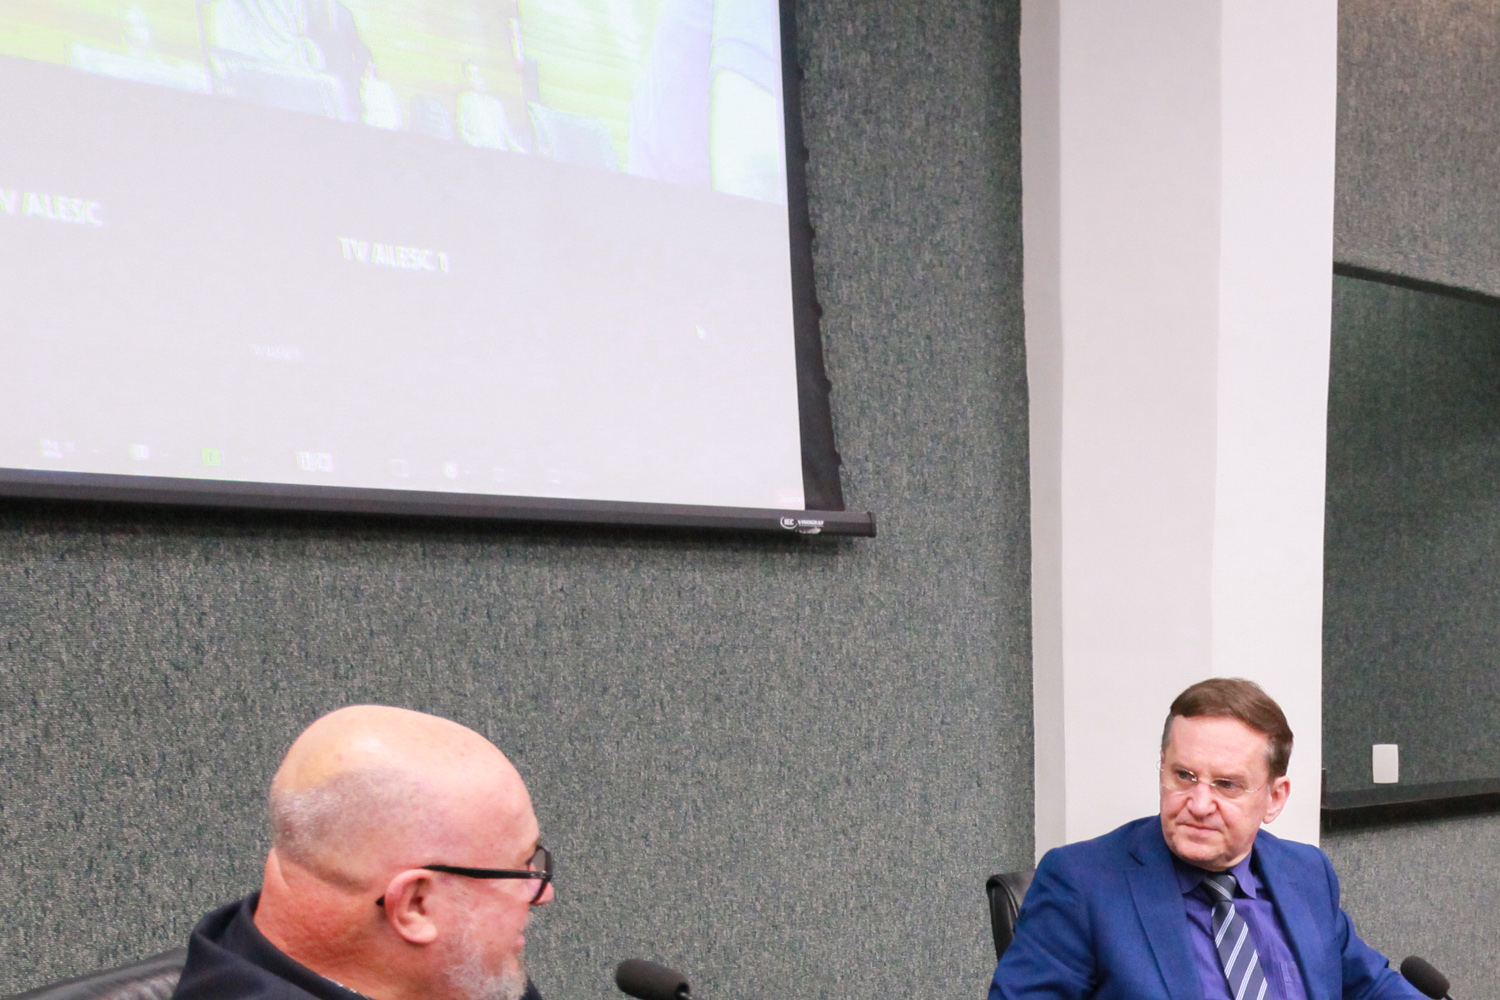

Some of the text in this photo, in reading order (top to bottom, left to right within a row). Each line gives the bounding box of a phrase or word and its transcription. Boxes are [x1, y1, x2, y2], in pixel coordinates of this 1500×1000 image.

[22, 191, 104, 227] ALESC
[337, 237, 368, 262] TV
[371, 242, 435, 271] ALESC
